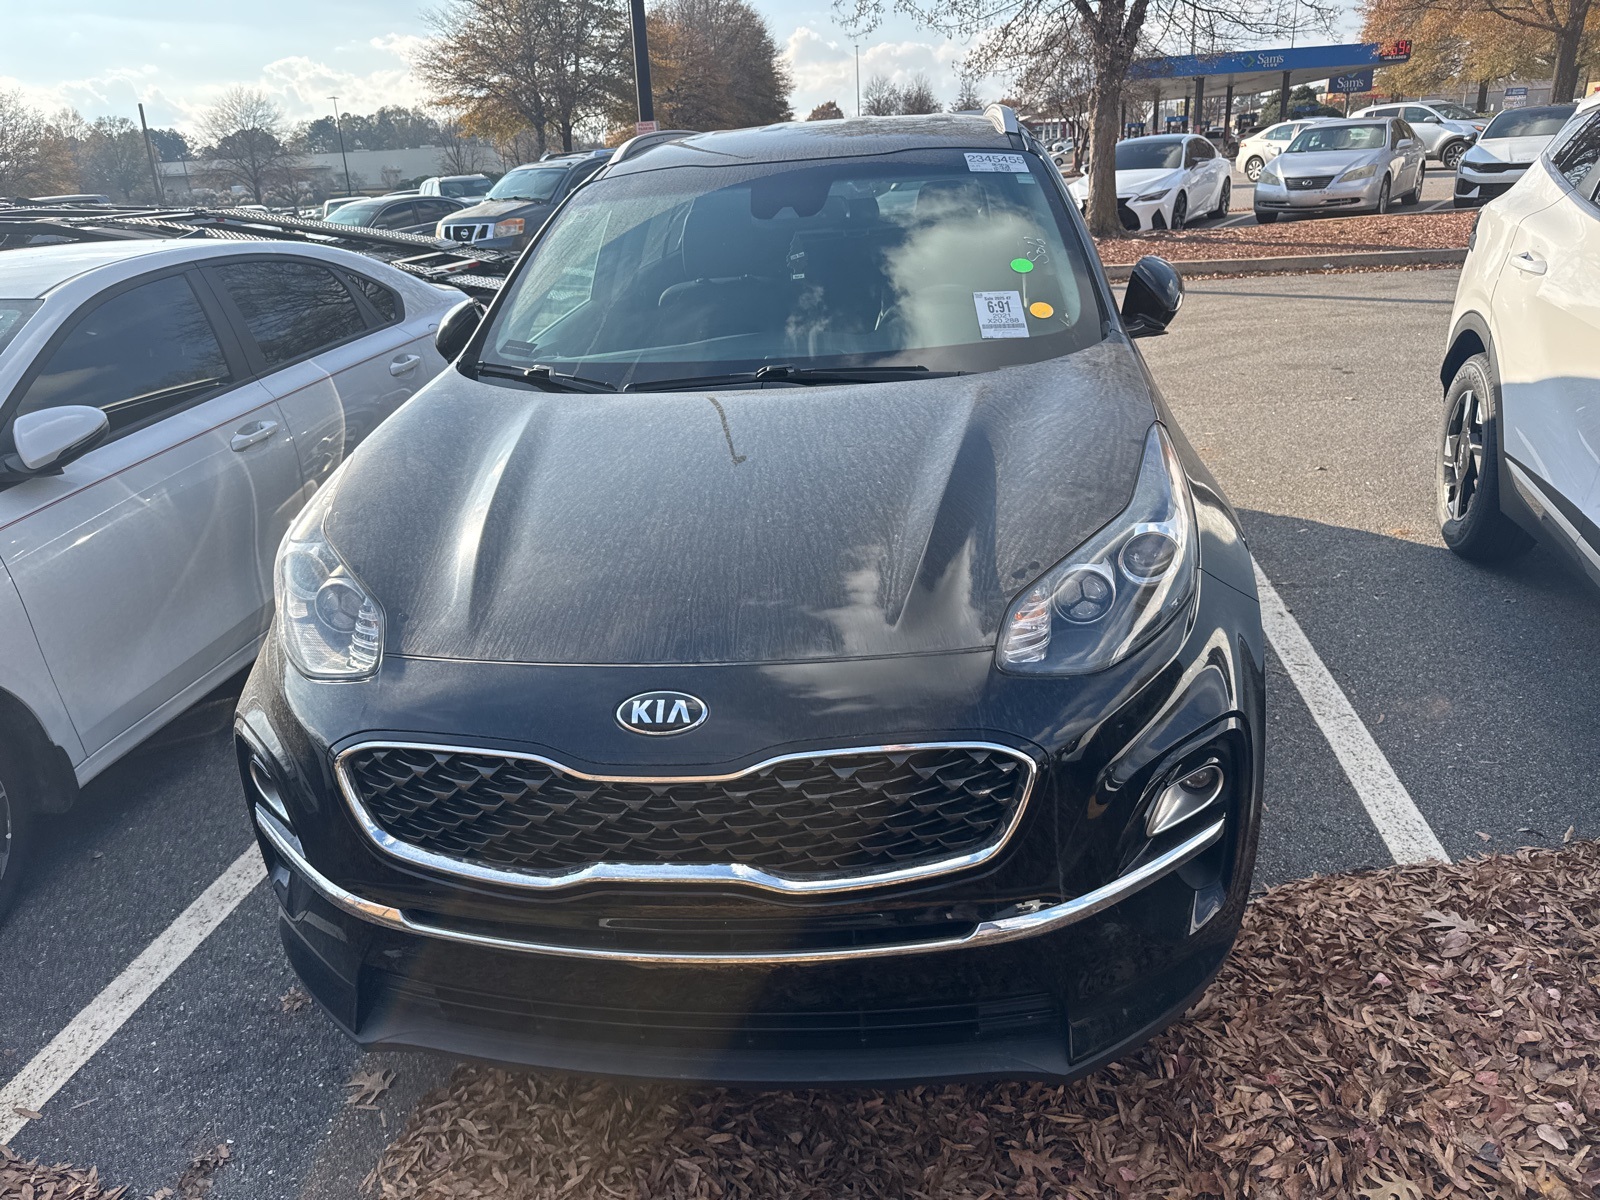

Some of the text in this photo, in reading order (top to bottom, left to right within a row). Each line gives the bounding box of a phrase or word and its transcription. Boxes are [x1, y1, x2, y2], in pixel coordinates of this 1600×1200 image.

[1257, 53, 1284, 65] Sam's
[1337, 76, 1364, 89] Sam's
[967, 154, 1025, 164] 2345455
[987, 300, 1011, 313] 6:91
[631, 699, 691, 724] KIA
